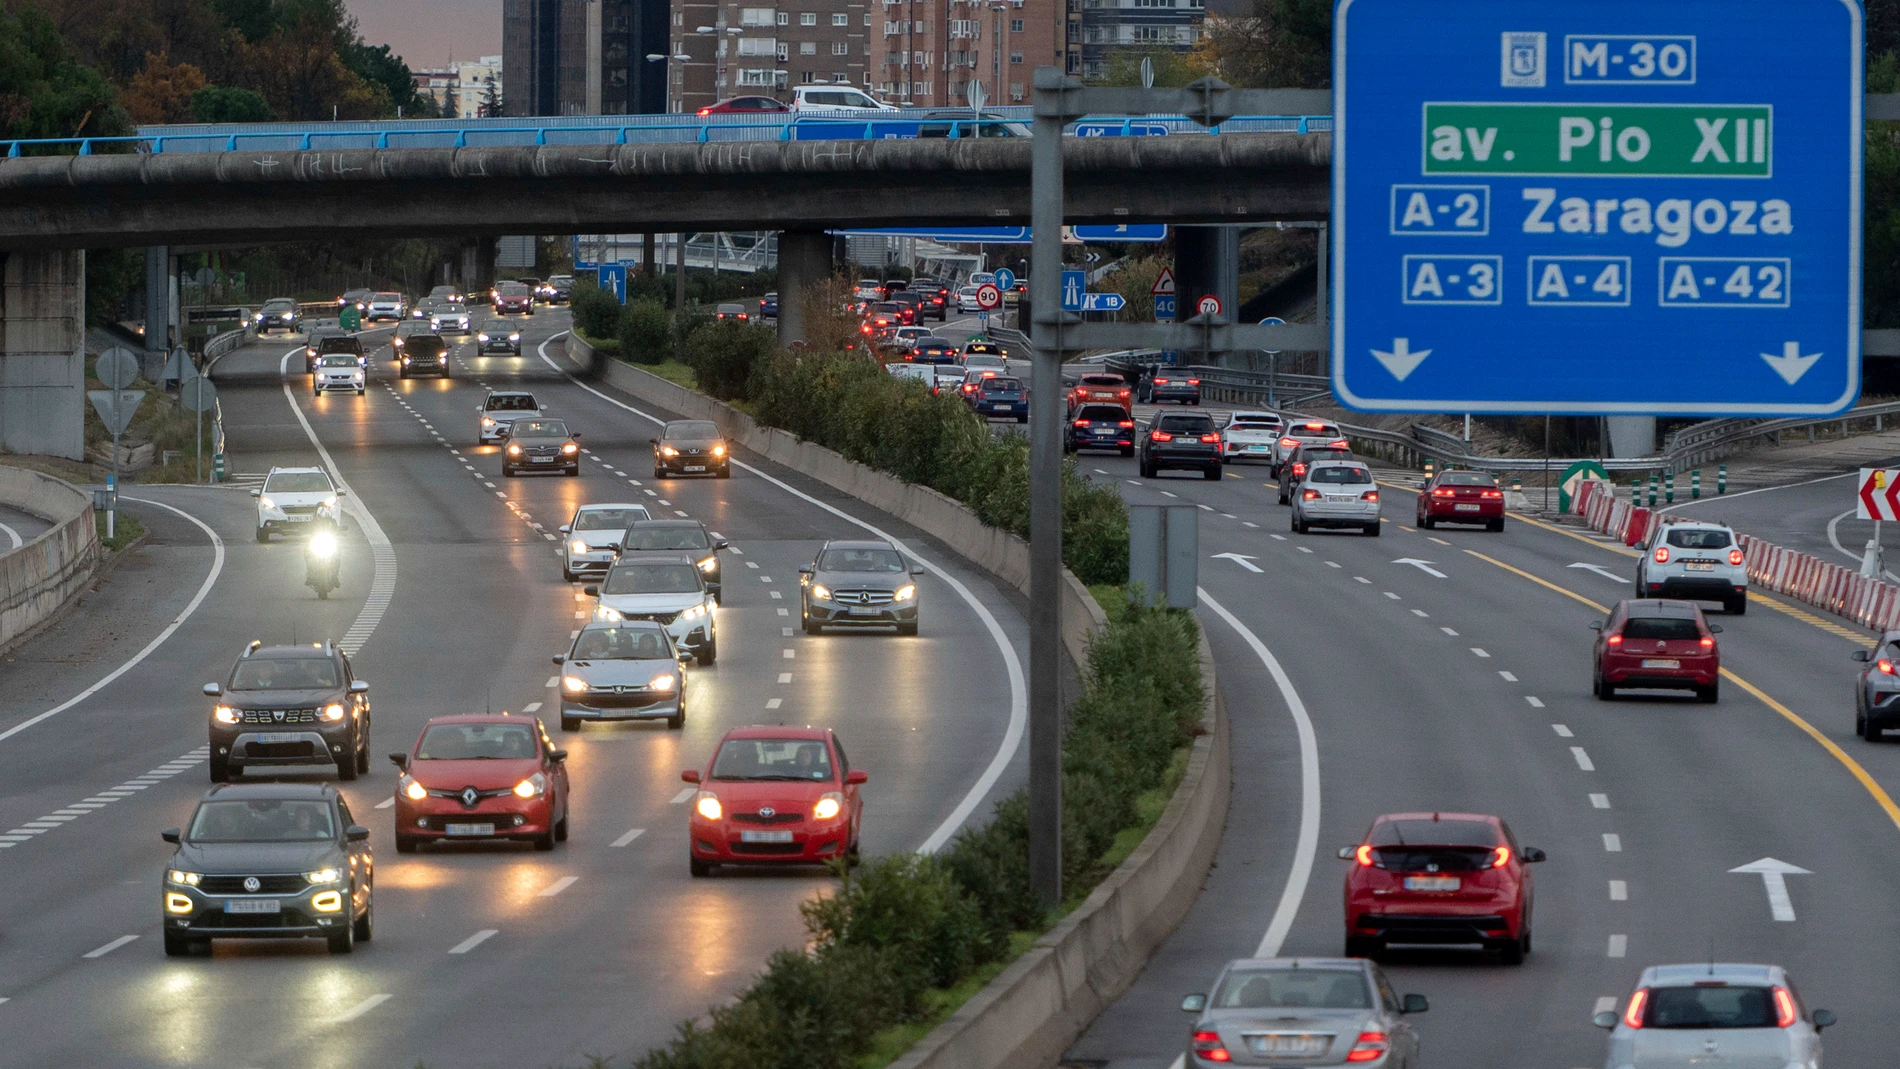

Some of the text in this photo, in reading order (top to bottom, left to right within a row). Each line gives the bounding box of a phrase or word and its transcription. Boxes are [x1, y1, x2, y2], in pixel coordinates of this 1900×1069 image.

[1572, 42, 1687, 77] M-30
[1431, 116, 1766, 163] av. Pio XII
[1402, 188, 1794, 248] A-2 Zaragoza
[1412, 262, 1783, 299] A-3 A-4 A-42
[981, 292, 996, 301] 90
[1105, 296, 1119, 307] 1B
[1156, 301, 1175, 312] 40
[1202, 302, 1217, 312] 70
